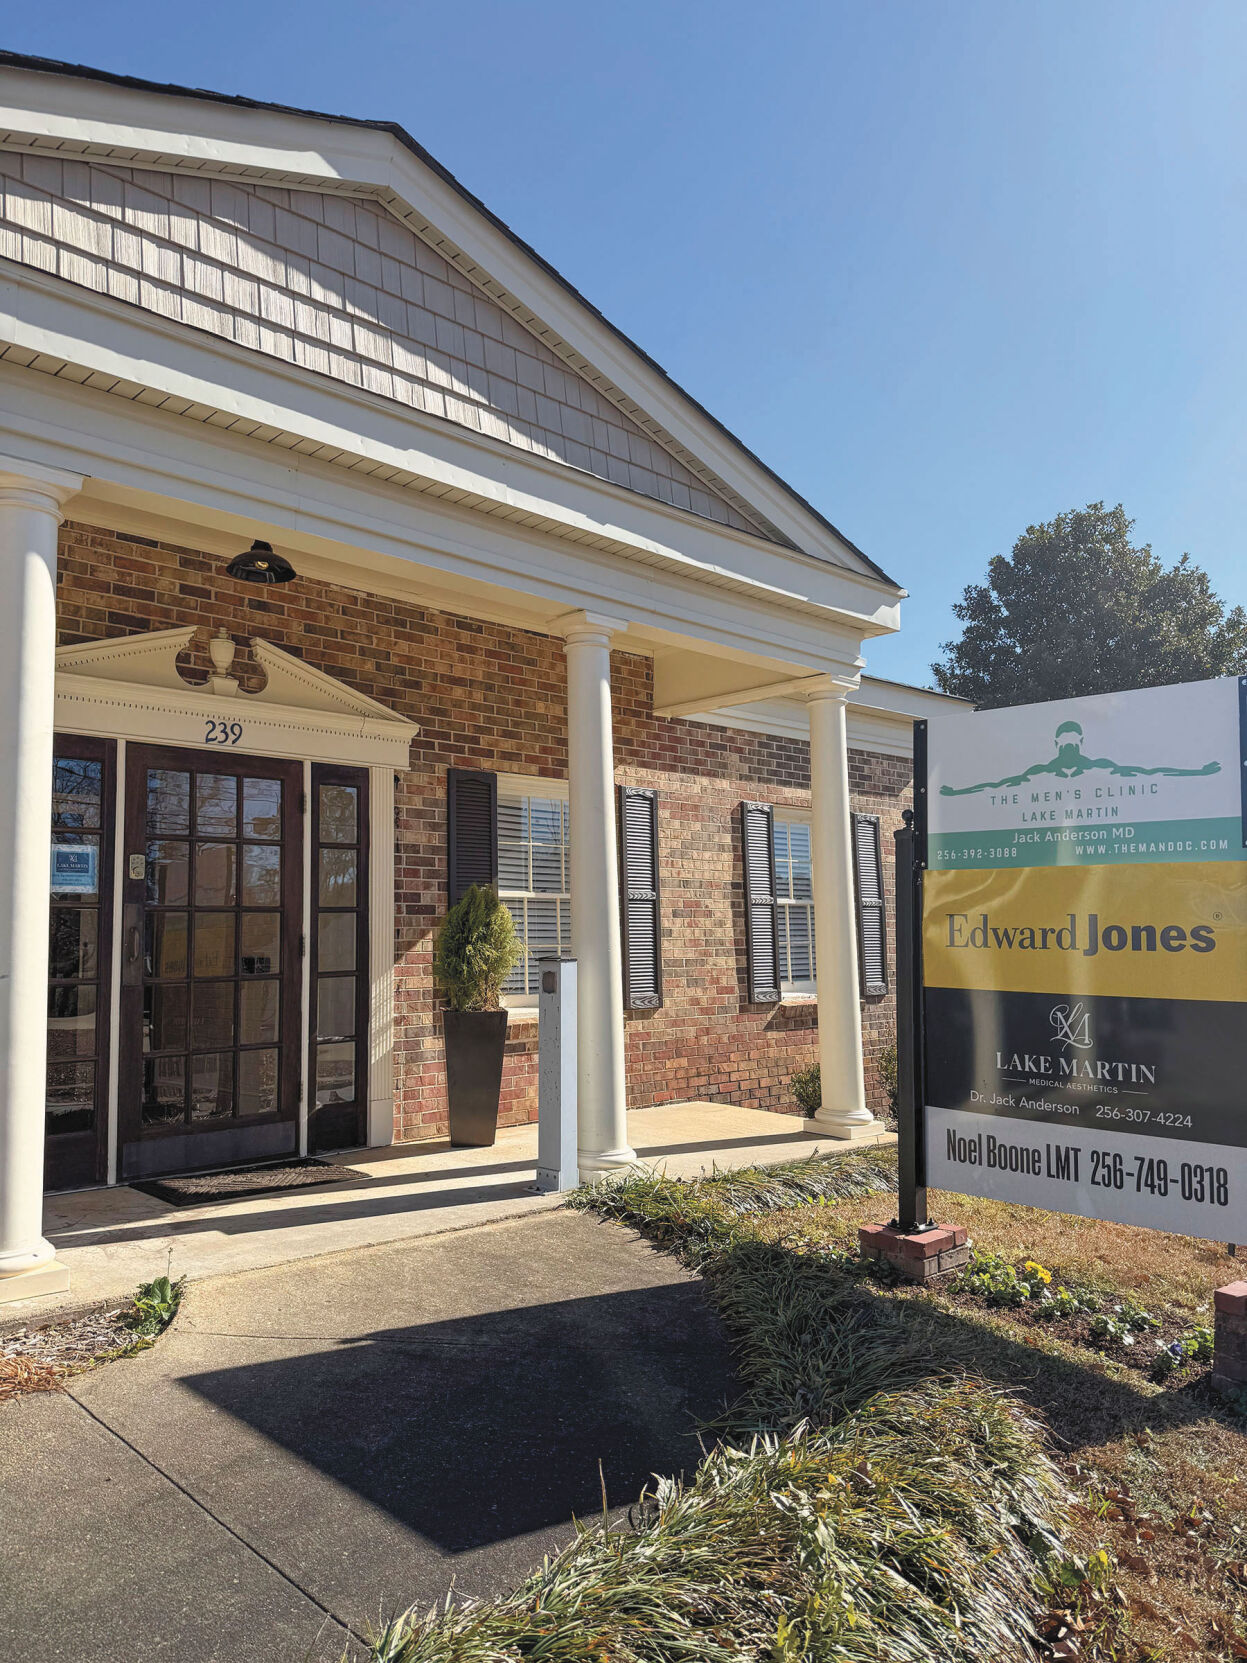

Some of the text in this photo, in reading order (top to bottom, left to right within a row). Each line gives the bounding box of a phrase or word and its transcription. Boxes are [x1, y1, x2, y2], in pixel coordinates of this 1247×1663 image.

[205, 719, 243, 745] 239
[991, 783, 1158, 806] THE MEN'S CLINIC
[1022, 806, 1119, 822] LAKE MARTIN
[1012, 827, 1135, 843] Jack Anderson MD
[1075, 839, 1228, 855] WWW.THEMANDOC.COM
[996, 1051, 1156, 1084] LAKE MARTIN
[1029, 1077, 1119, 1094] MEDICAL AESTHETICS
[970, 1090, 1193, 1128] Dr. Jack Anderson 256-307-4224
[946, 1128, 1229, 1207] Noel Boone LMT 256-749-0318
